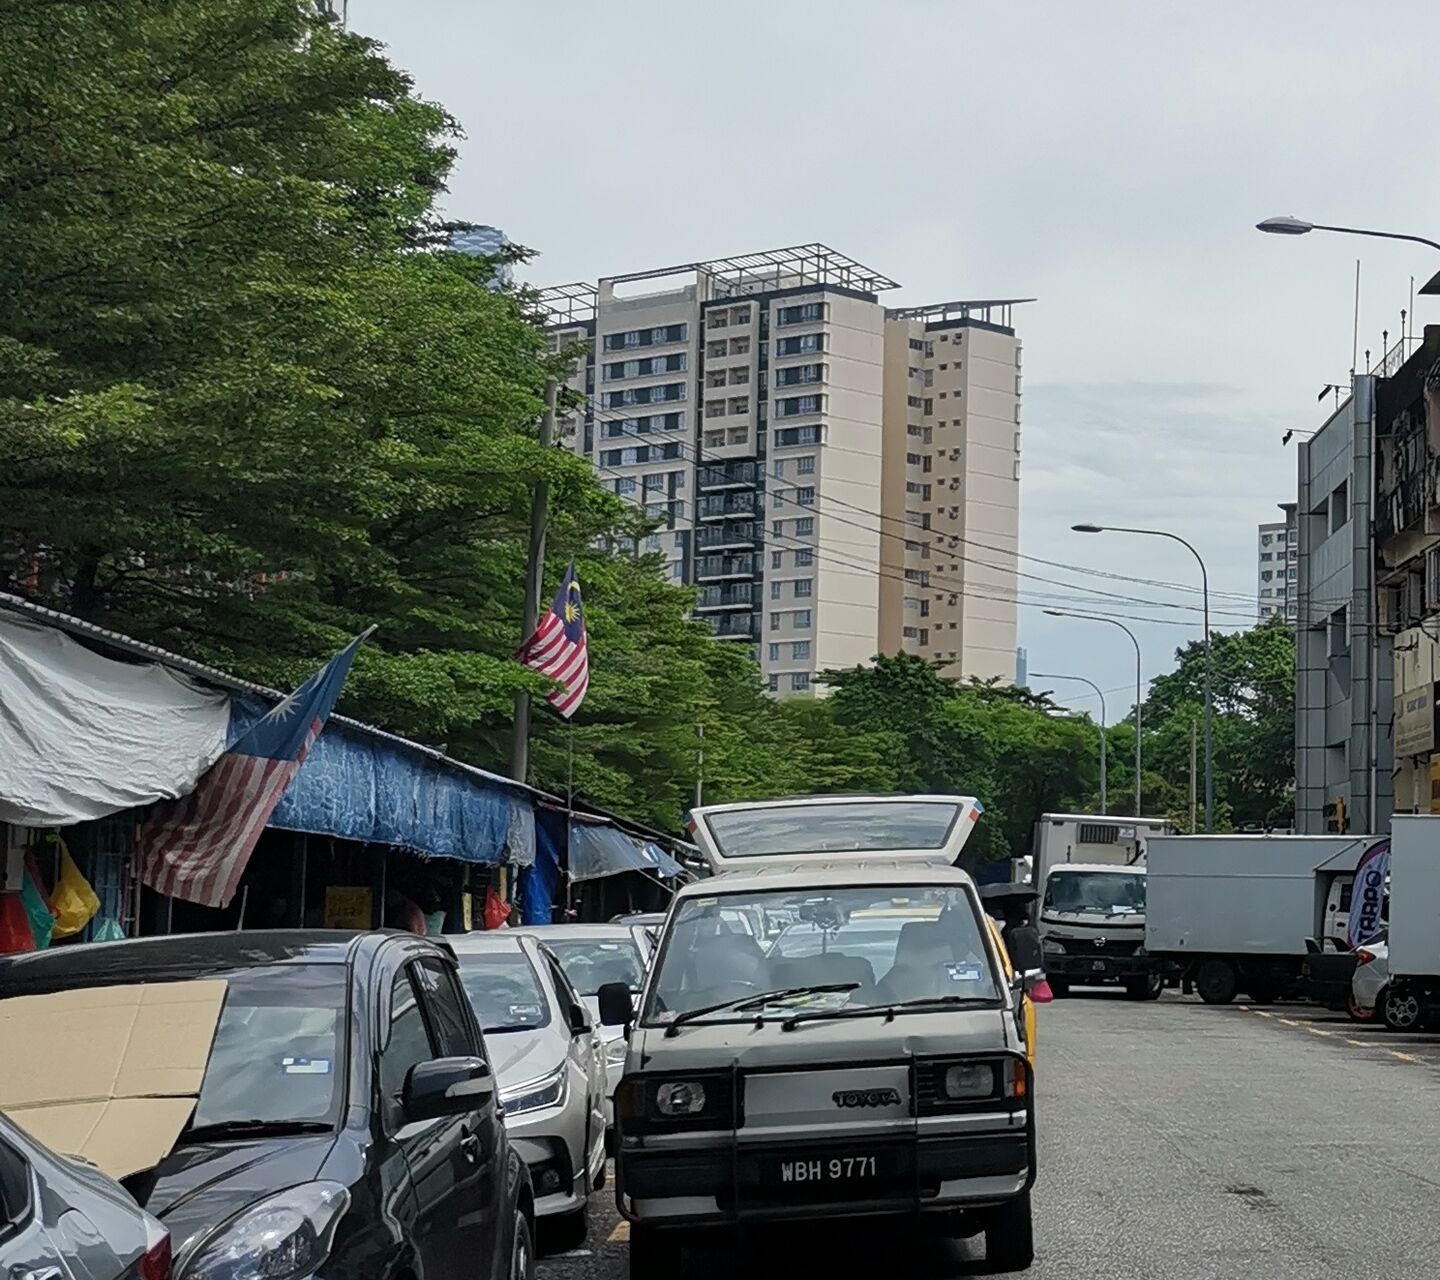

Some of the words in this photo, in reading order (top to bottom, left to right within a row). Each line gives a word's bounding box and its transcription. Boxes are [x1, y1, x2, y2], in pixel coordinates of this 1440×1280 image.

[833, 1088, 902, 1108] TOYOTA
[782, 1160, 822, 1182] WBH
[829, 1156, 876, 1178] 9771
